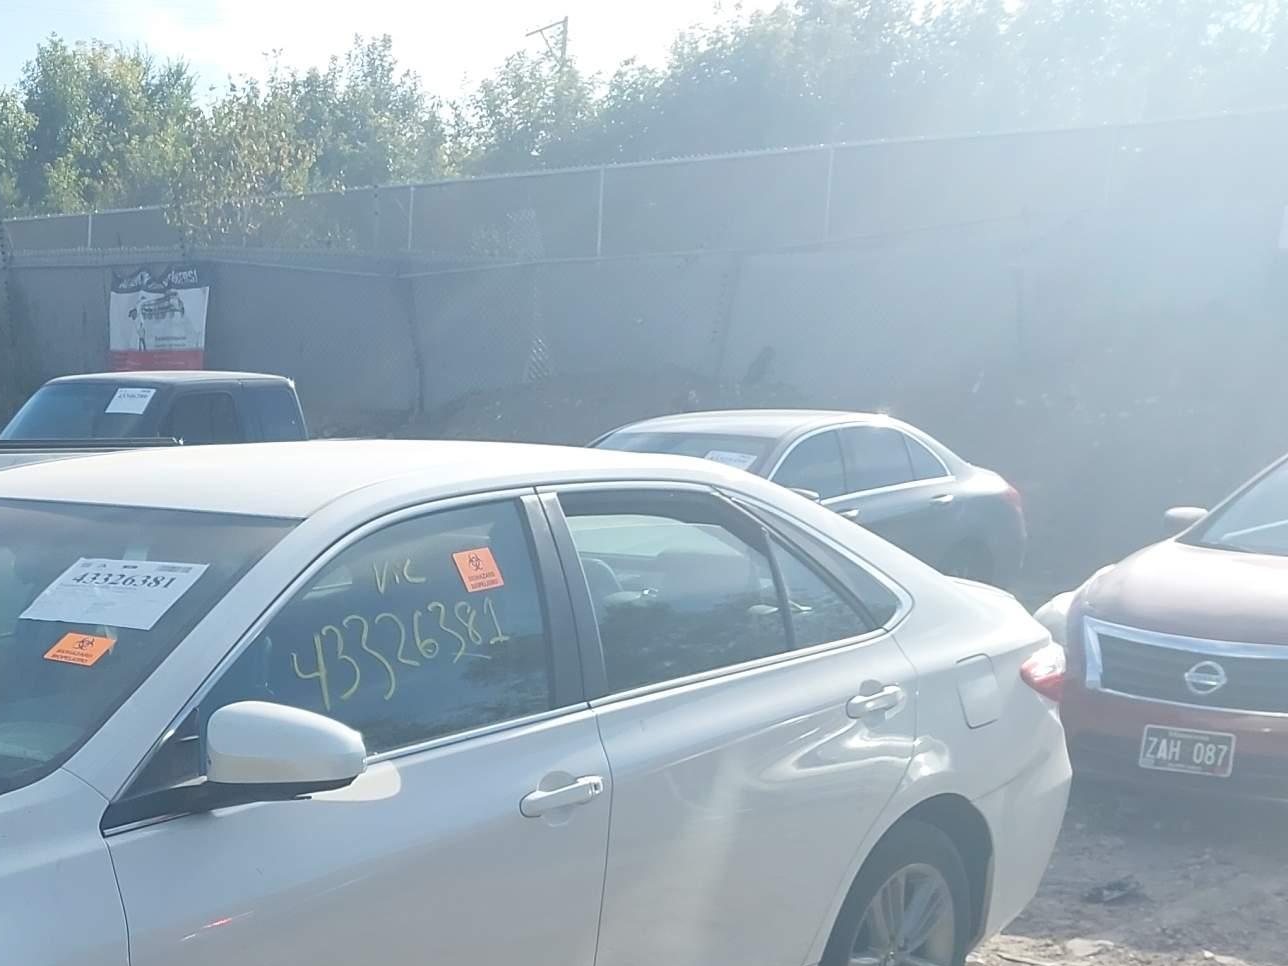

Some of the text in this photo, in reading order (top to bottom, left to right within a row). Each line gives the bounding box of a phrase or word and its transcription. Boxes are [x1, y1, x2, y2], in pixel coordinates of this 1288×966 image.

[72, 572, 177, 589] 43326381
[291, 597, 510, 712] 43326381
[1145, 737, 1228, 767] ZAH 087
